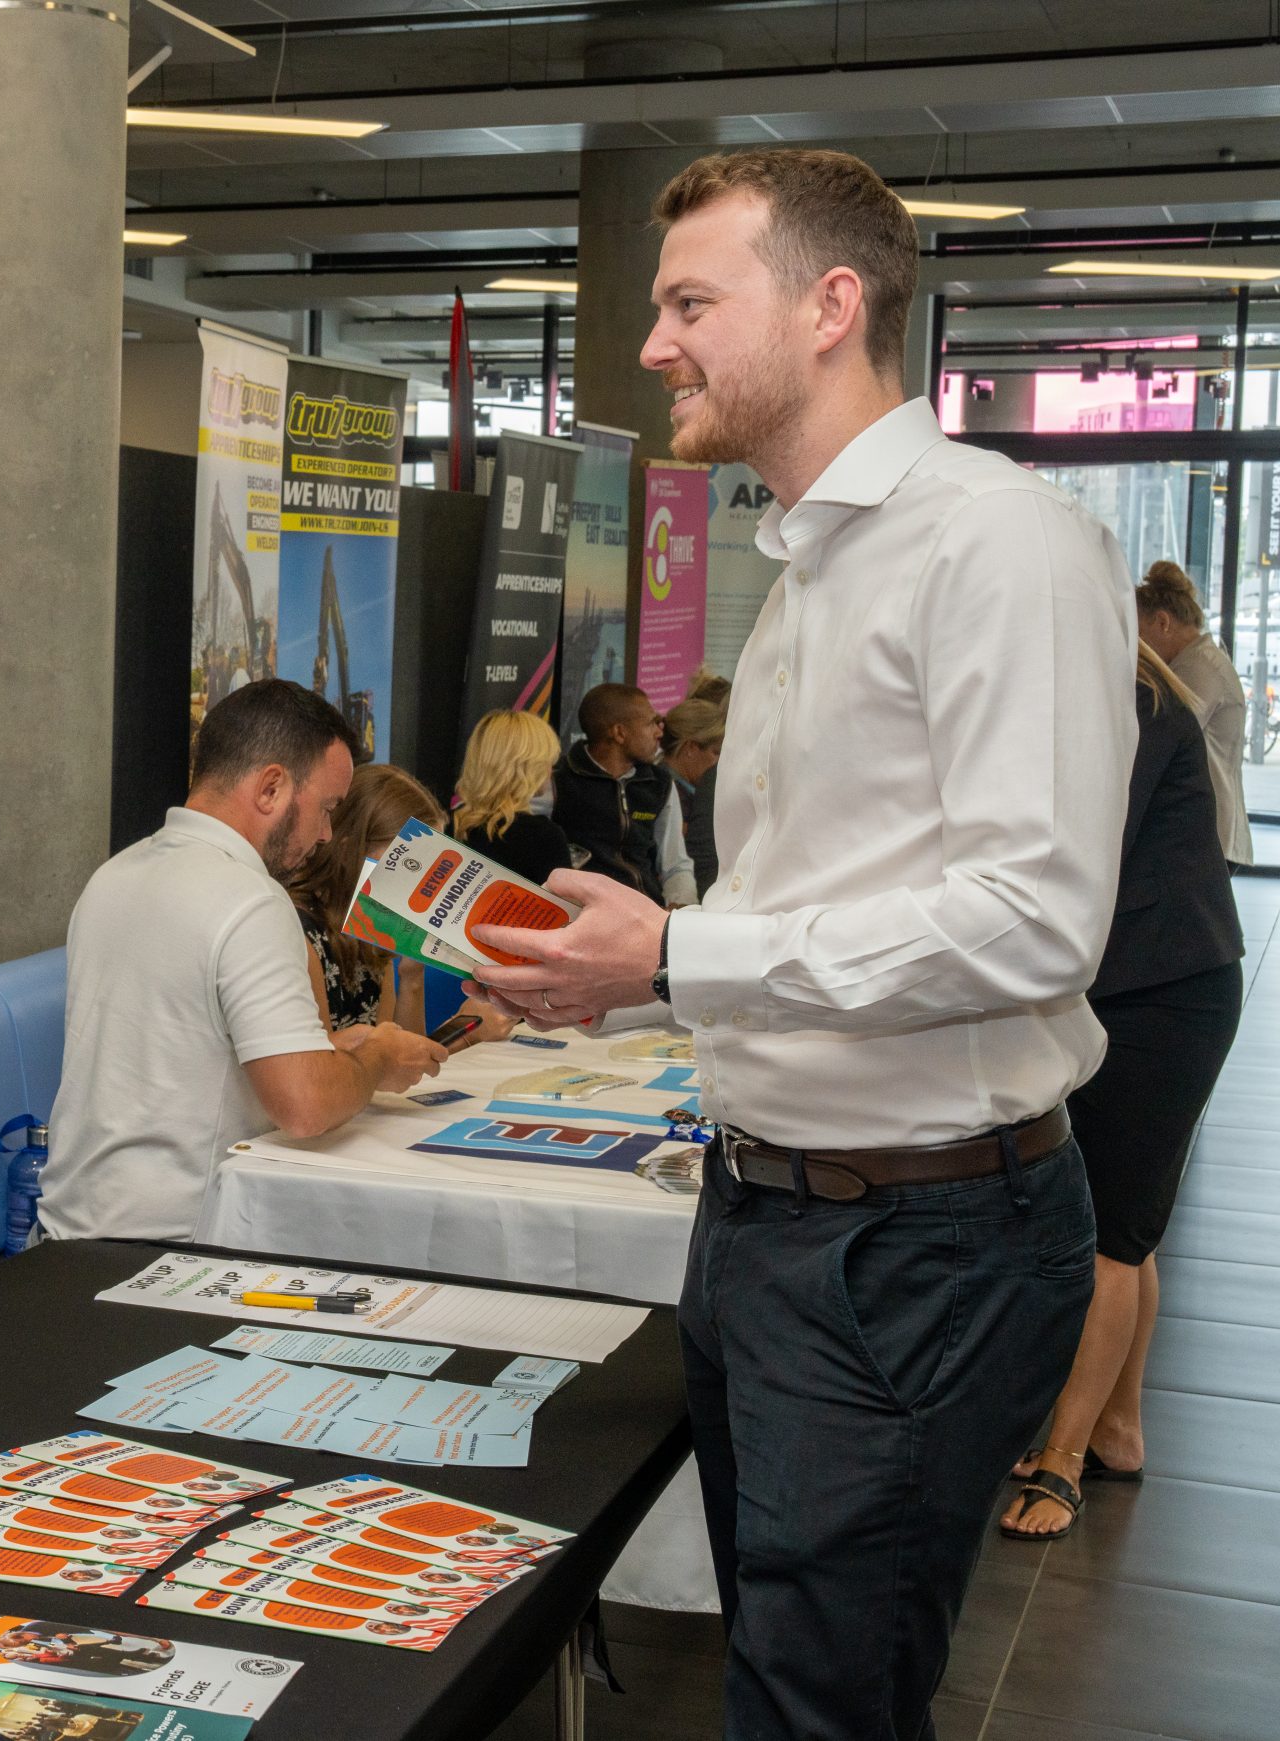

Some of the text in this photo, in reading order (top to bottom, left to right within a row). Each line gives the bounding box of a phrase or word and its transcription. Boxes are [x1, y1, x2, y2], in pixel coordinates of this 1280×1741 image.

[290, 394, 398, 440] tru7group
[210, 432, 280, 464] APPRENTICESHIPS
[296, 457, 393, 478] EXPERIENCED OPERATOR?
[283, 481, 313, 506] WE
[317, 483, 362, 510] WANT
[495, 574, 563, 594] APPRENTICESHIPS
[491, 619, 538, 637] VOCATIONAL
[485, 665, 518, 682] T-LEVELS
[385, 843, 410, 871] ISCRE
[420, 859, 455, 898] BEYOND
[428, 860, 484, 928] BOUNDARIES
[127, 1265, 176, 1290] SIGN UP
[195, 1272, 243, 1298] SIGN UP
[284, 1279, 308, 1291] UP
[72, 1445, 144, 1467] BOUNDARIES
[343, 1492, 423, 1515] BOUNDARIES
[151, 1669, 185, 1698] Friends
[170, 1690, 184, 1700] of
[183, 1681, 212, 1703] ISCRE
[154, 1710, 177, 1733] Powers
